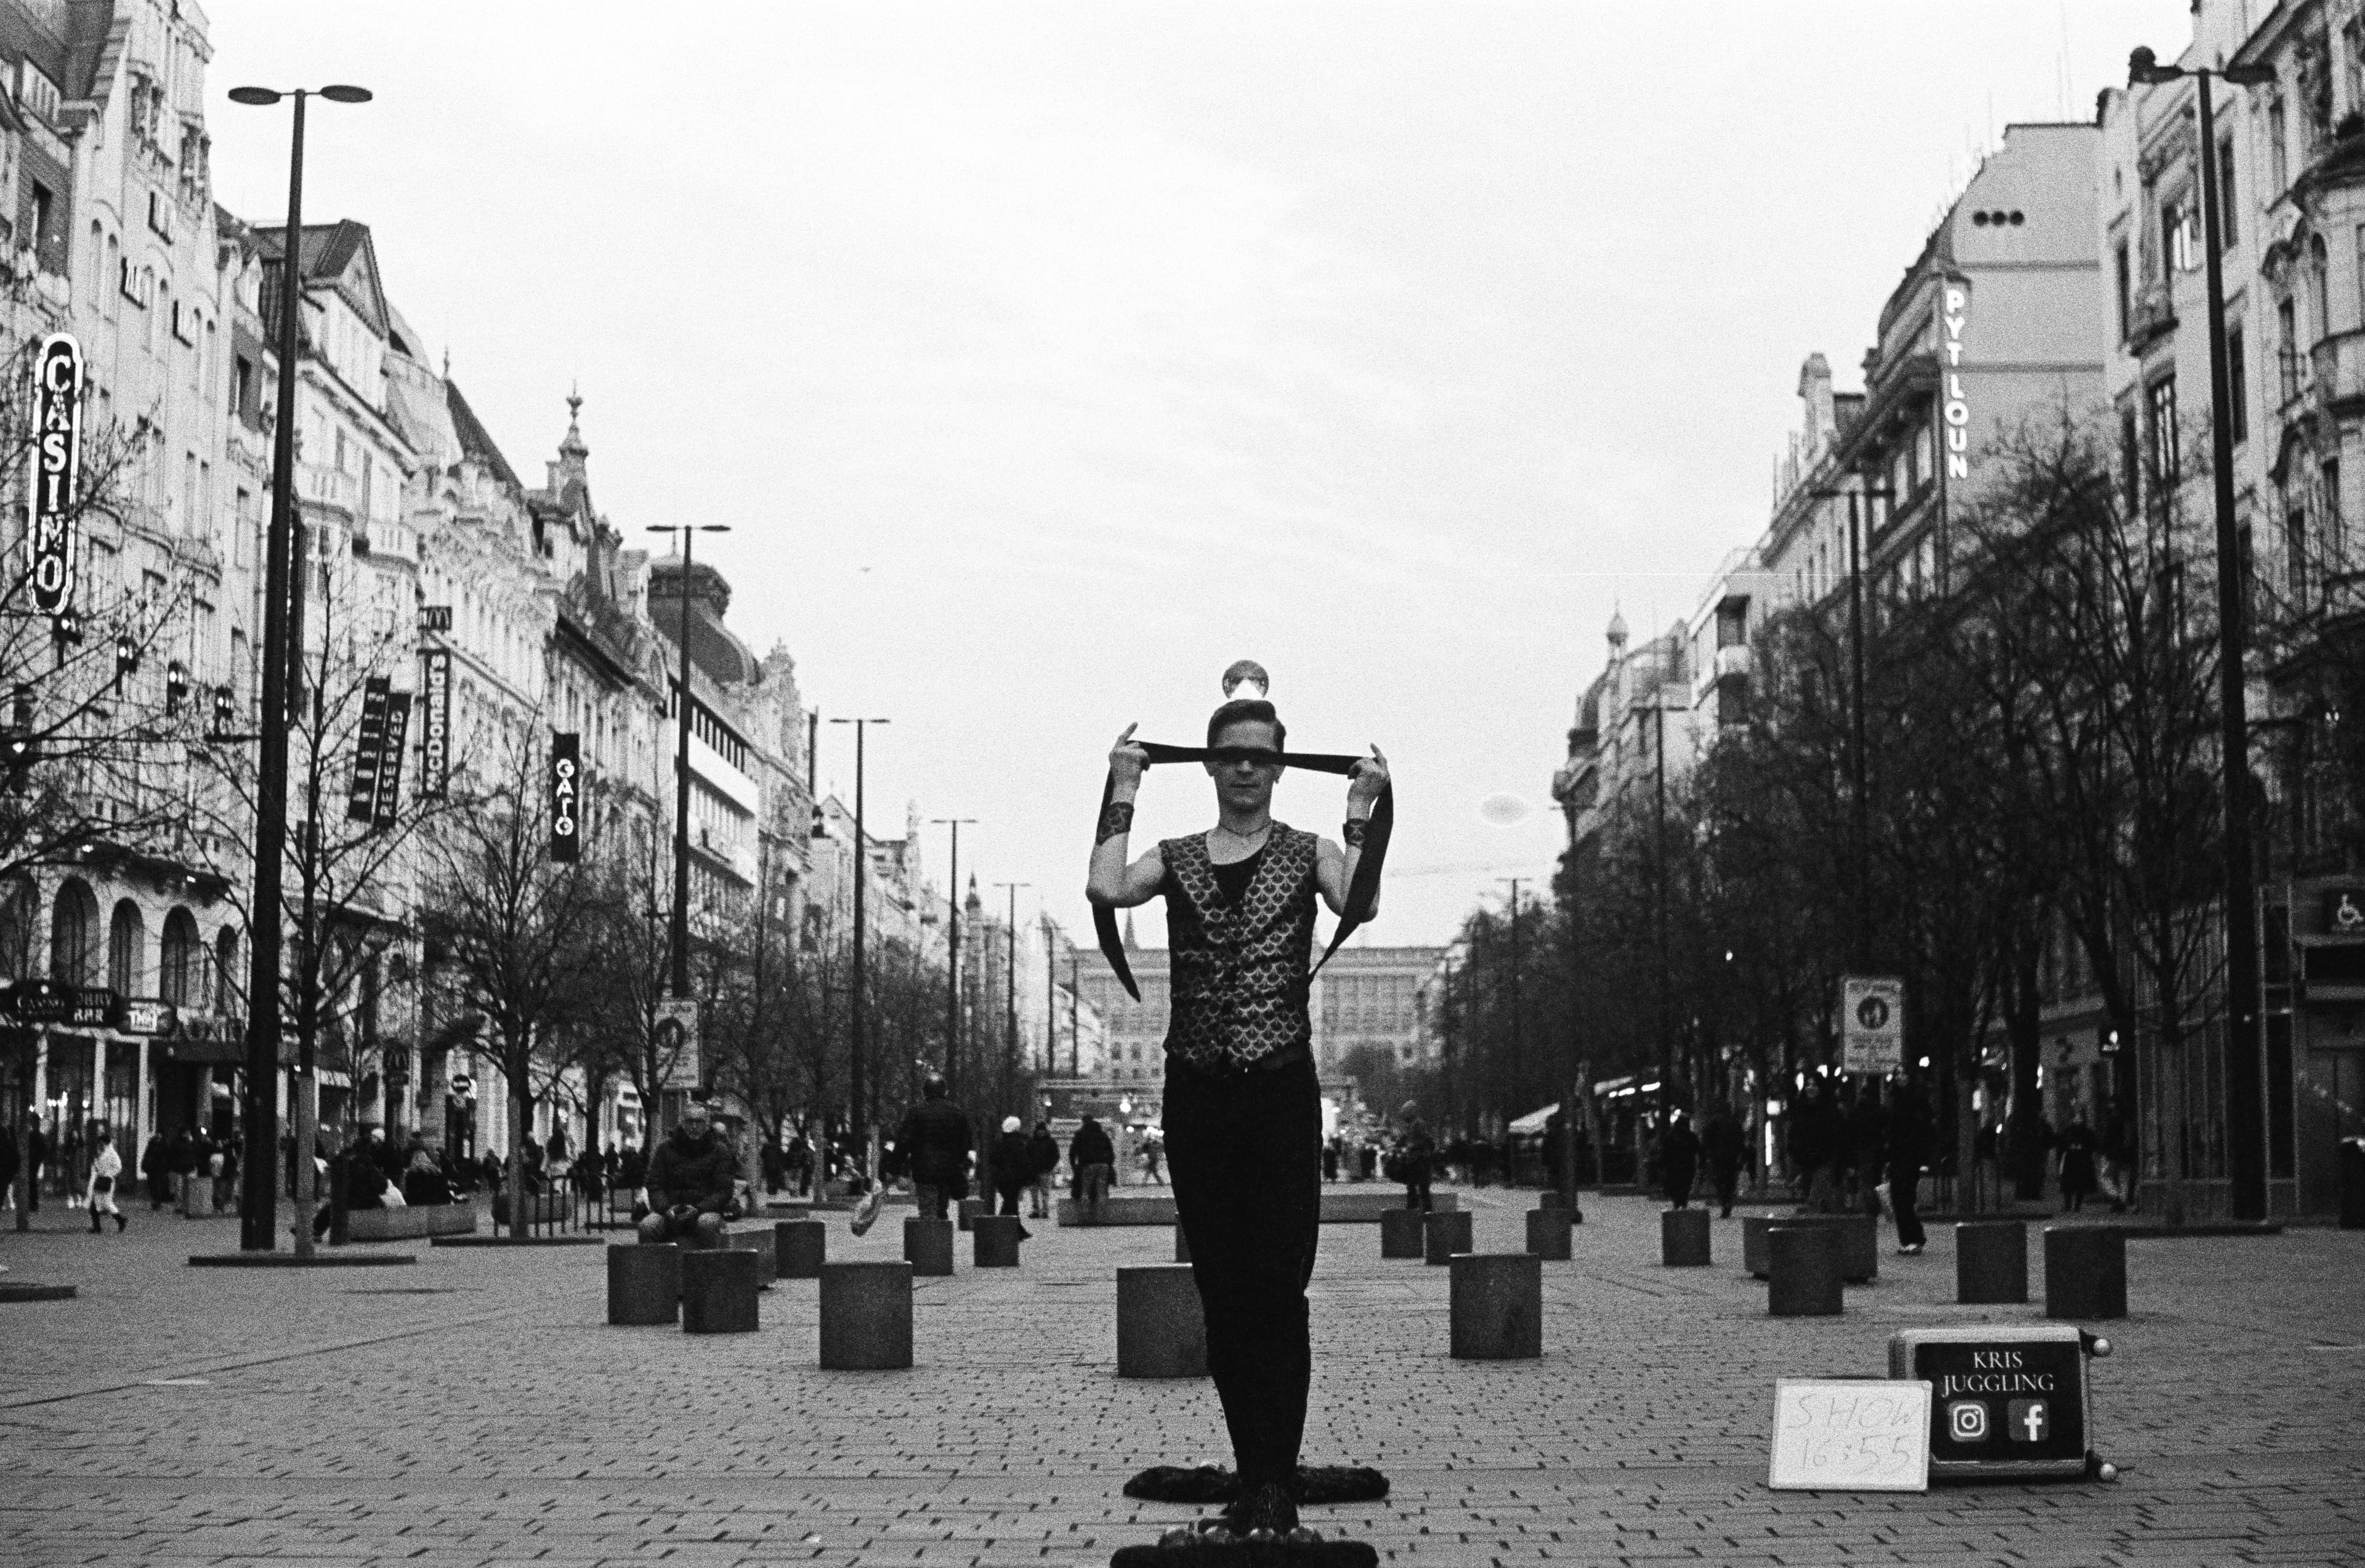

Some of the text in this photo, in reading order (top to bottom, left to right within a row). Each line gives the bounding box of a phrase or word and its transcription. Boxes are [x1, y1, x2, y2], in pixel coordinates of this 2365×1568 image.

[1944, 289, 1969, 479] PYTLOUN
[37, 354, 71, 592] CASINO
[379, 710, 404, 817] RESERVED
[1942, 1373, 2055, 1397] JUGGLING
[1973, 1351, 2023, 1369] KRIS
[1802, 1434, 1916, 1471] 16:55
